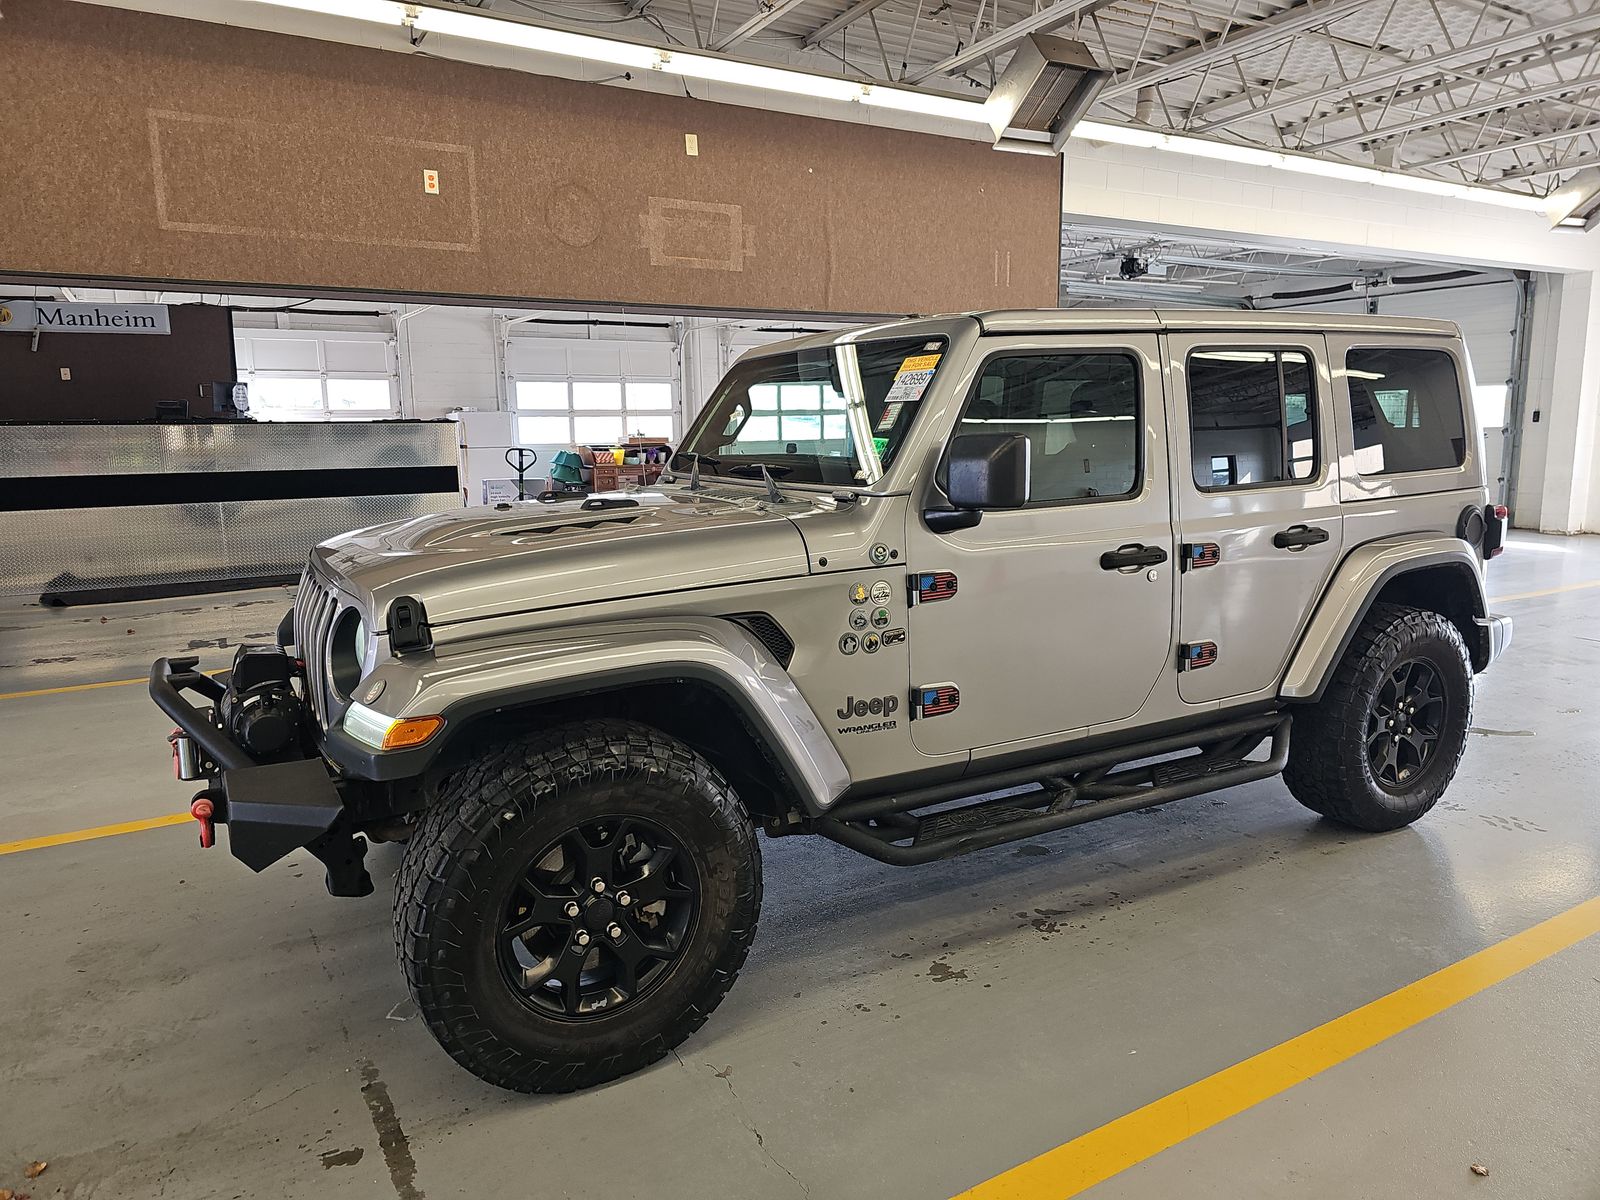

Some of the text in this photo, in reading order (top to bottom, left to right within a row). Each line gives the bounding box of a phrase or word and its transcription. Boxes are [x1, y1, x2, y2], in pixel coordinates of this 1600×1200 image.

[37, 307, 157, 328] Manheim
[837, 695, 898, 719] Jeep
[837, 720, 896, 734] WRANGLER
